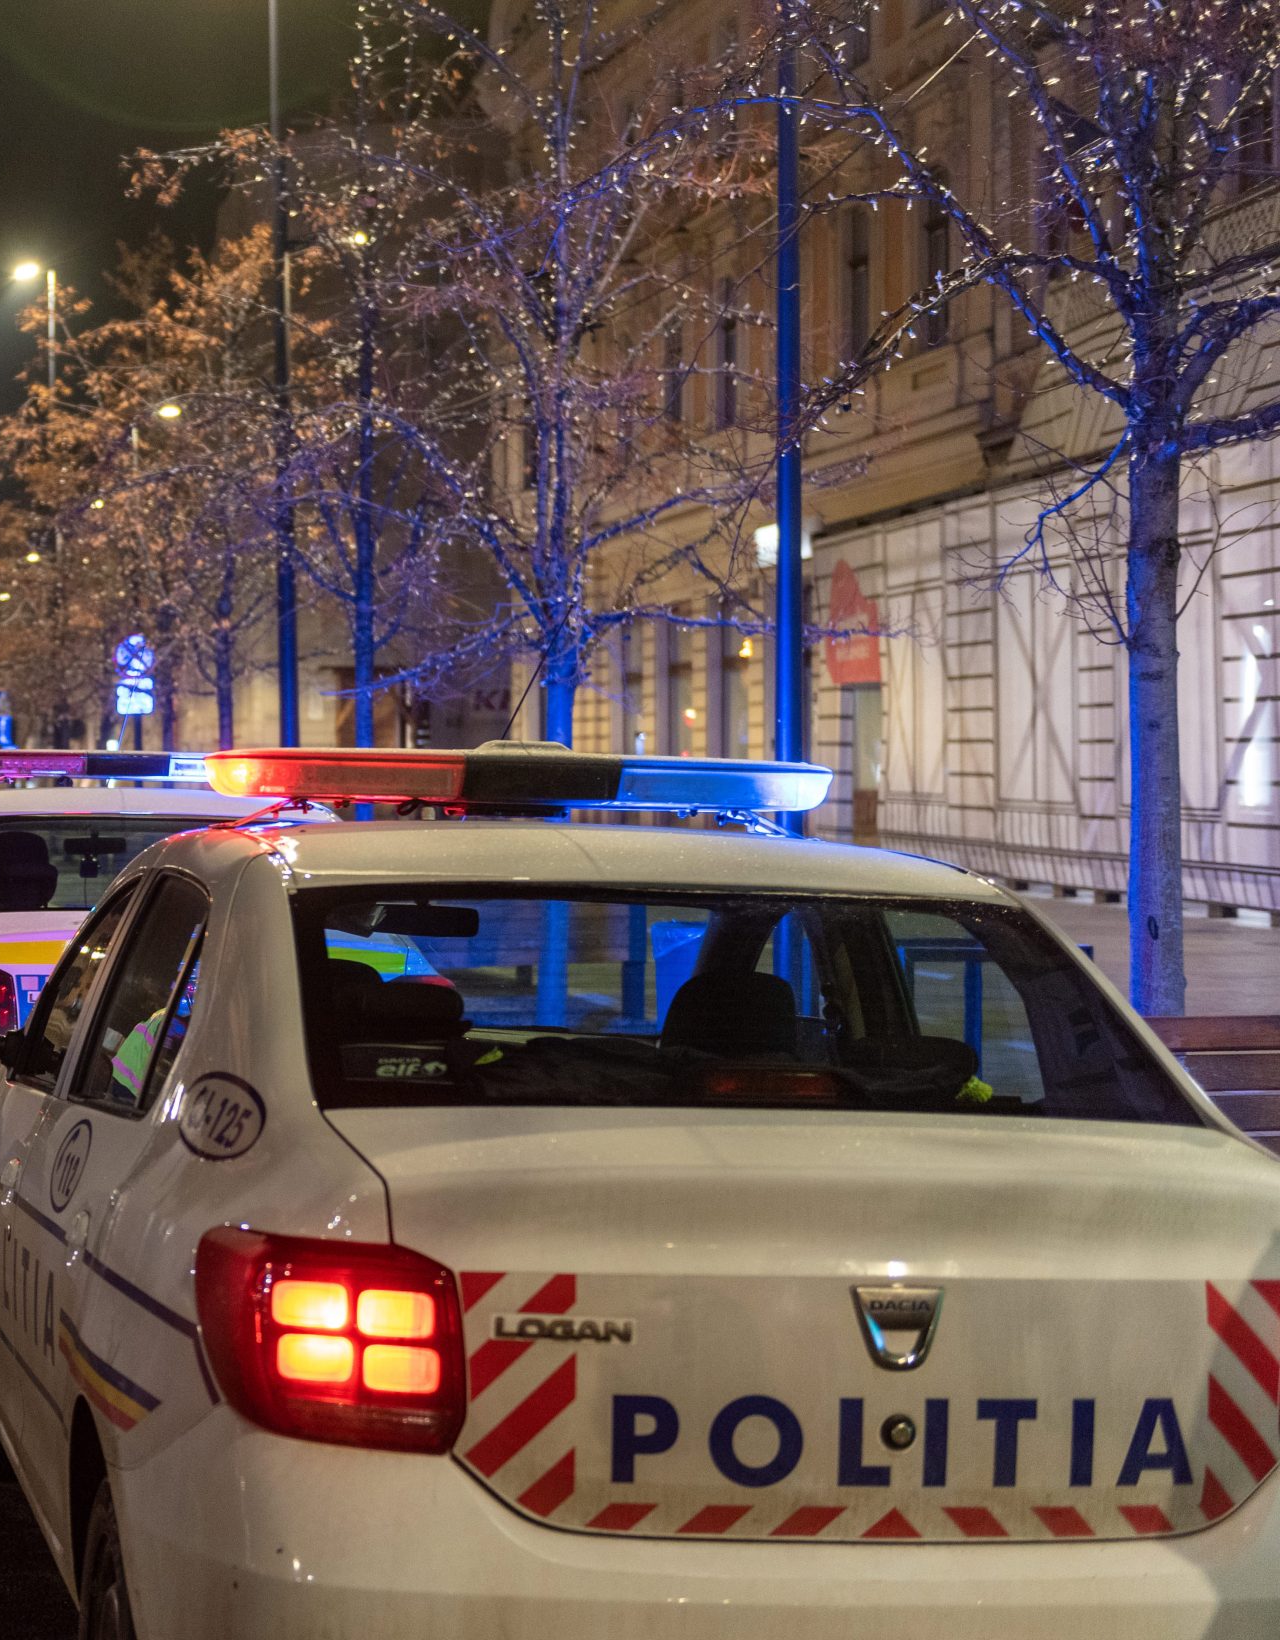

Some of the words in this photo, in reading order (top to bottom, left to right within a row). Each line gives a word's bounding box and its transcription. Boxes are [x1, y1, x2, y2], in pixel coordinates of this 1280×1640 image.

[870, 1300, 931, 1312] DACIA
[494, 1316, 632, 1343] LOGAN
[610, 1394, 1194, 1488] POLITIA
